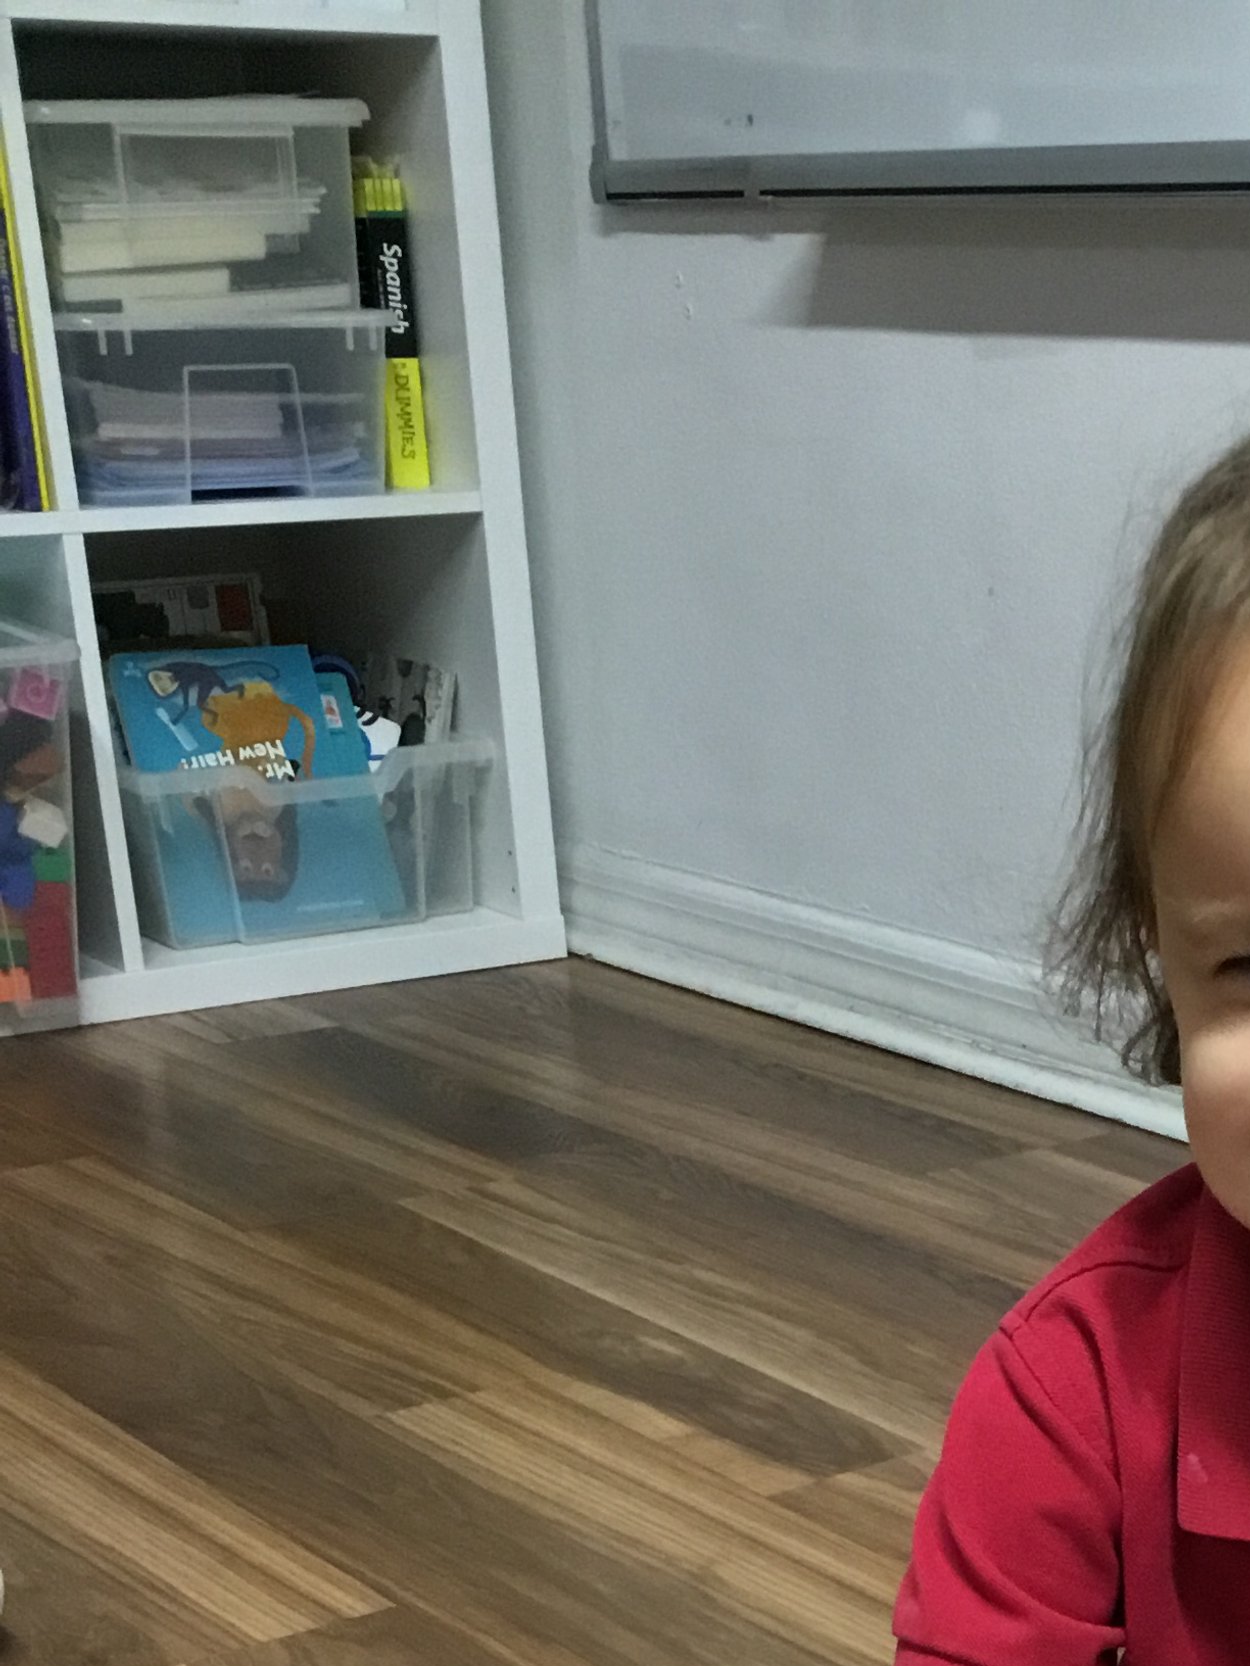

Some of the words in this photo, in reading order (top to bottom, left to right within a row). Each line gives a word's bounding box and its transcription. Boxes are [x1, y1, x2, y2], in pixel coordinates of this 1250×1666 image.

[379, 243, 409, 334] Spanish
[394, 374, 416, 460] DUMMIES
[239, 739, 286, 760] New
[257, 759, 295, 780] Mr.
